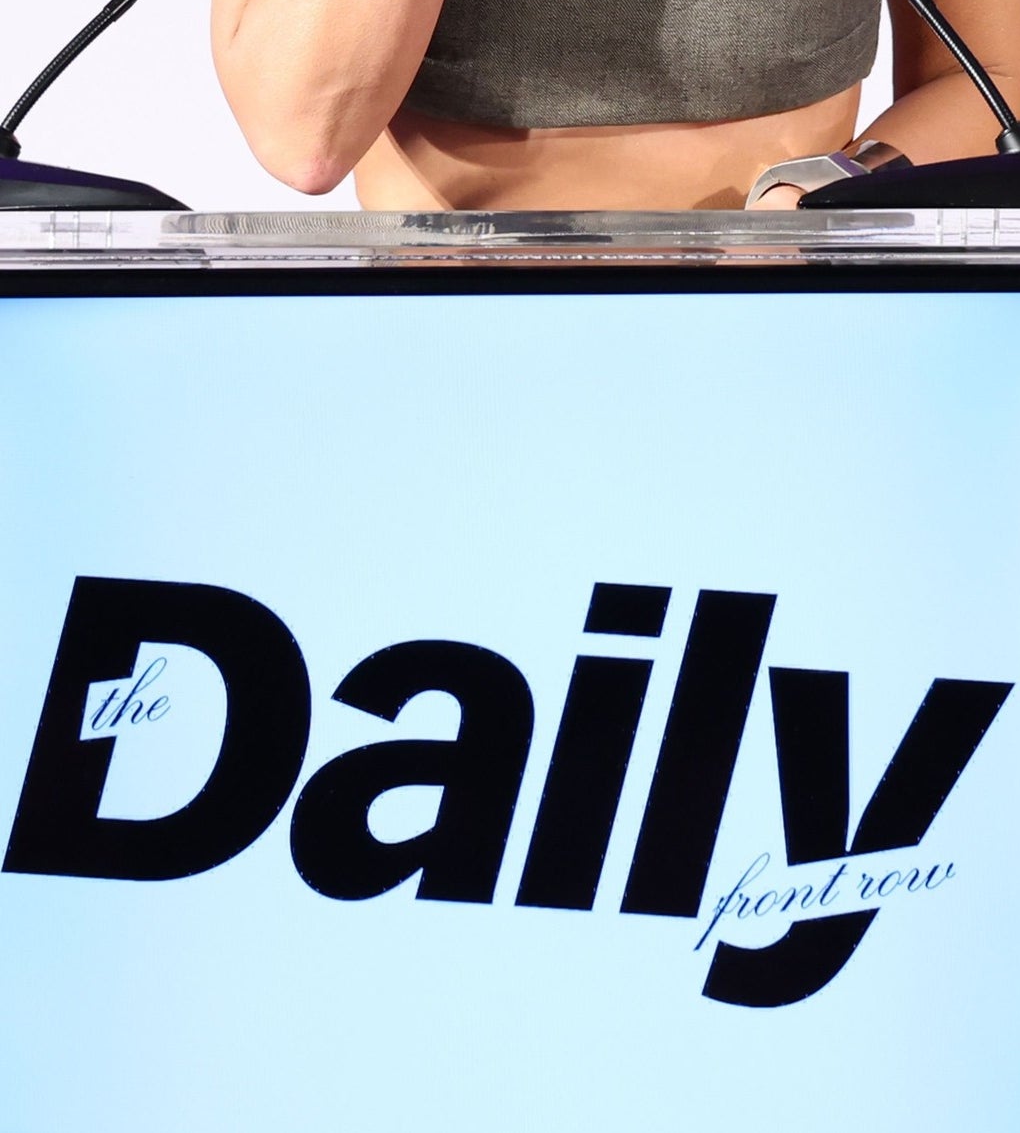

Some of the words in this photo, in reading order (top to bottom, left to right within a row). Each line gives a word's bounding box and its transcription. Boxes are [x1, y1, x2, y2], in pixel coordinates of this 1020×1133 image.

[90, 657, 172, 731] the
[1, 575, 1015, 1008] Daily
[693, 852, 848, 951] front
[854, 862, 956, 900] row
